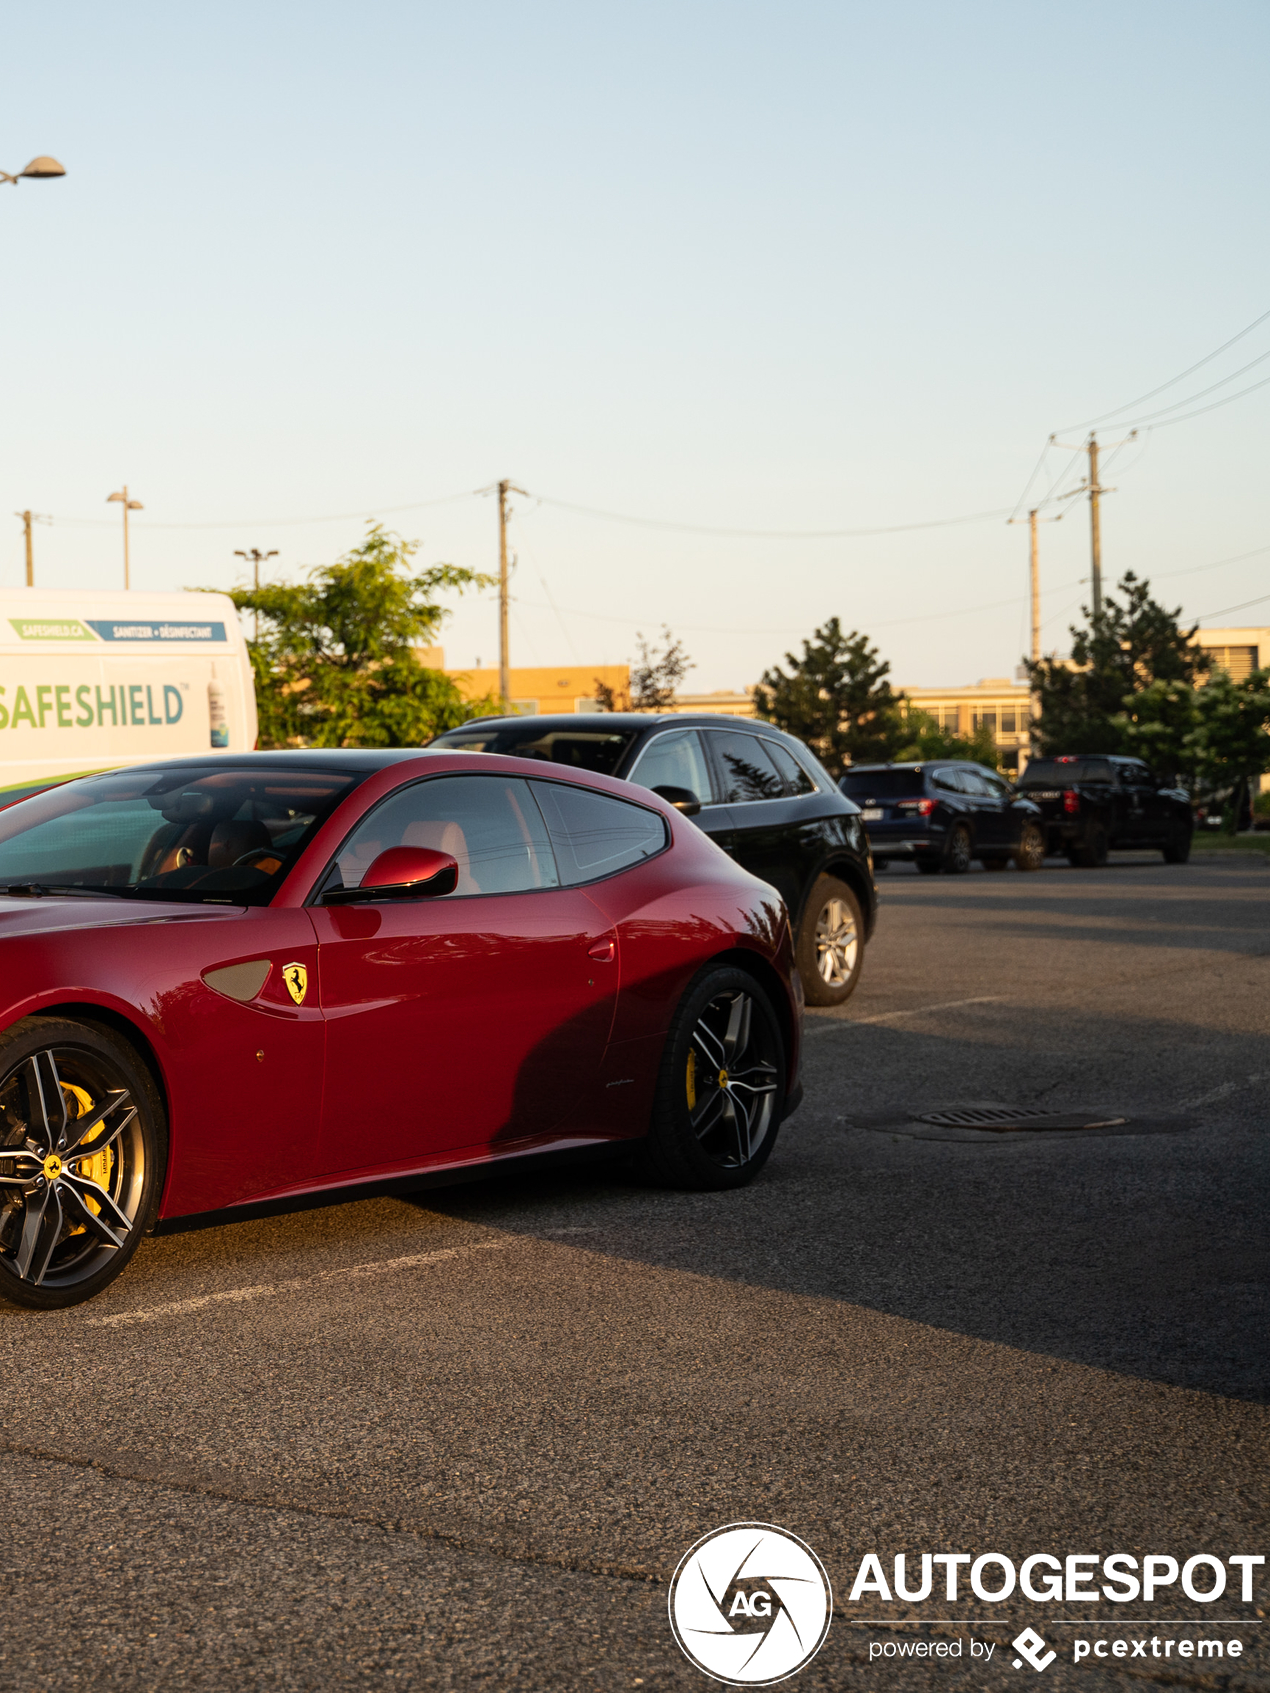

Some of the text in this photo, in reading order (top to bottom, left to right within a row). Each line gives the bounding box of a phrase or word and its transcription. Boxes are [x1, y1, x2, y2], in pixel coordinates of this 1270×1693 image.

[22, 624, 84, 637] SAFESHIELD.CA
[112, 623, 212, 638] SANITIZER DÉSINFECTANT
